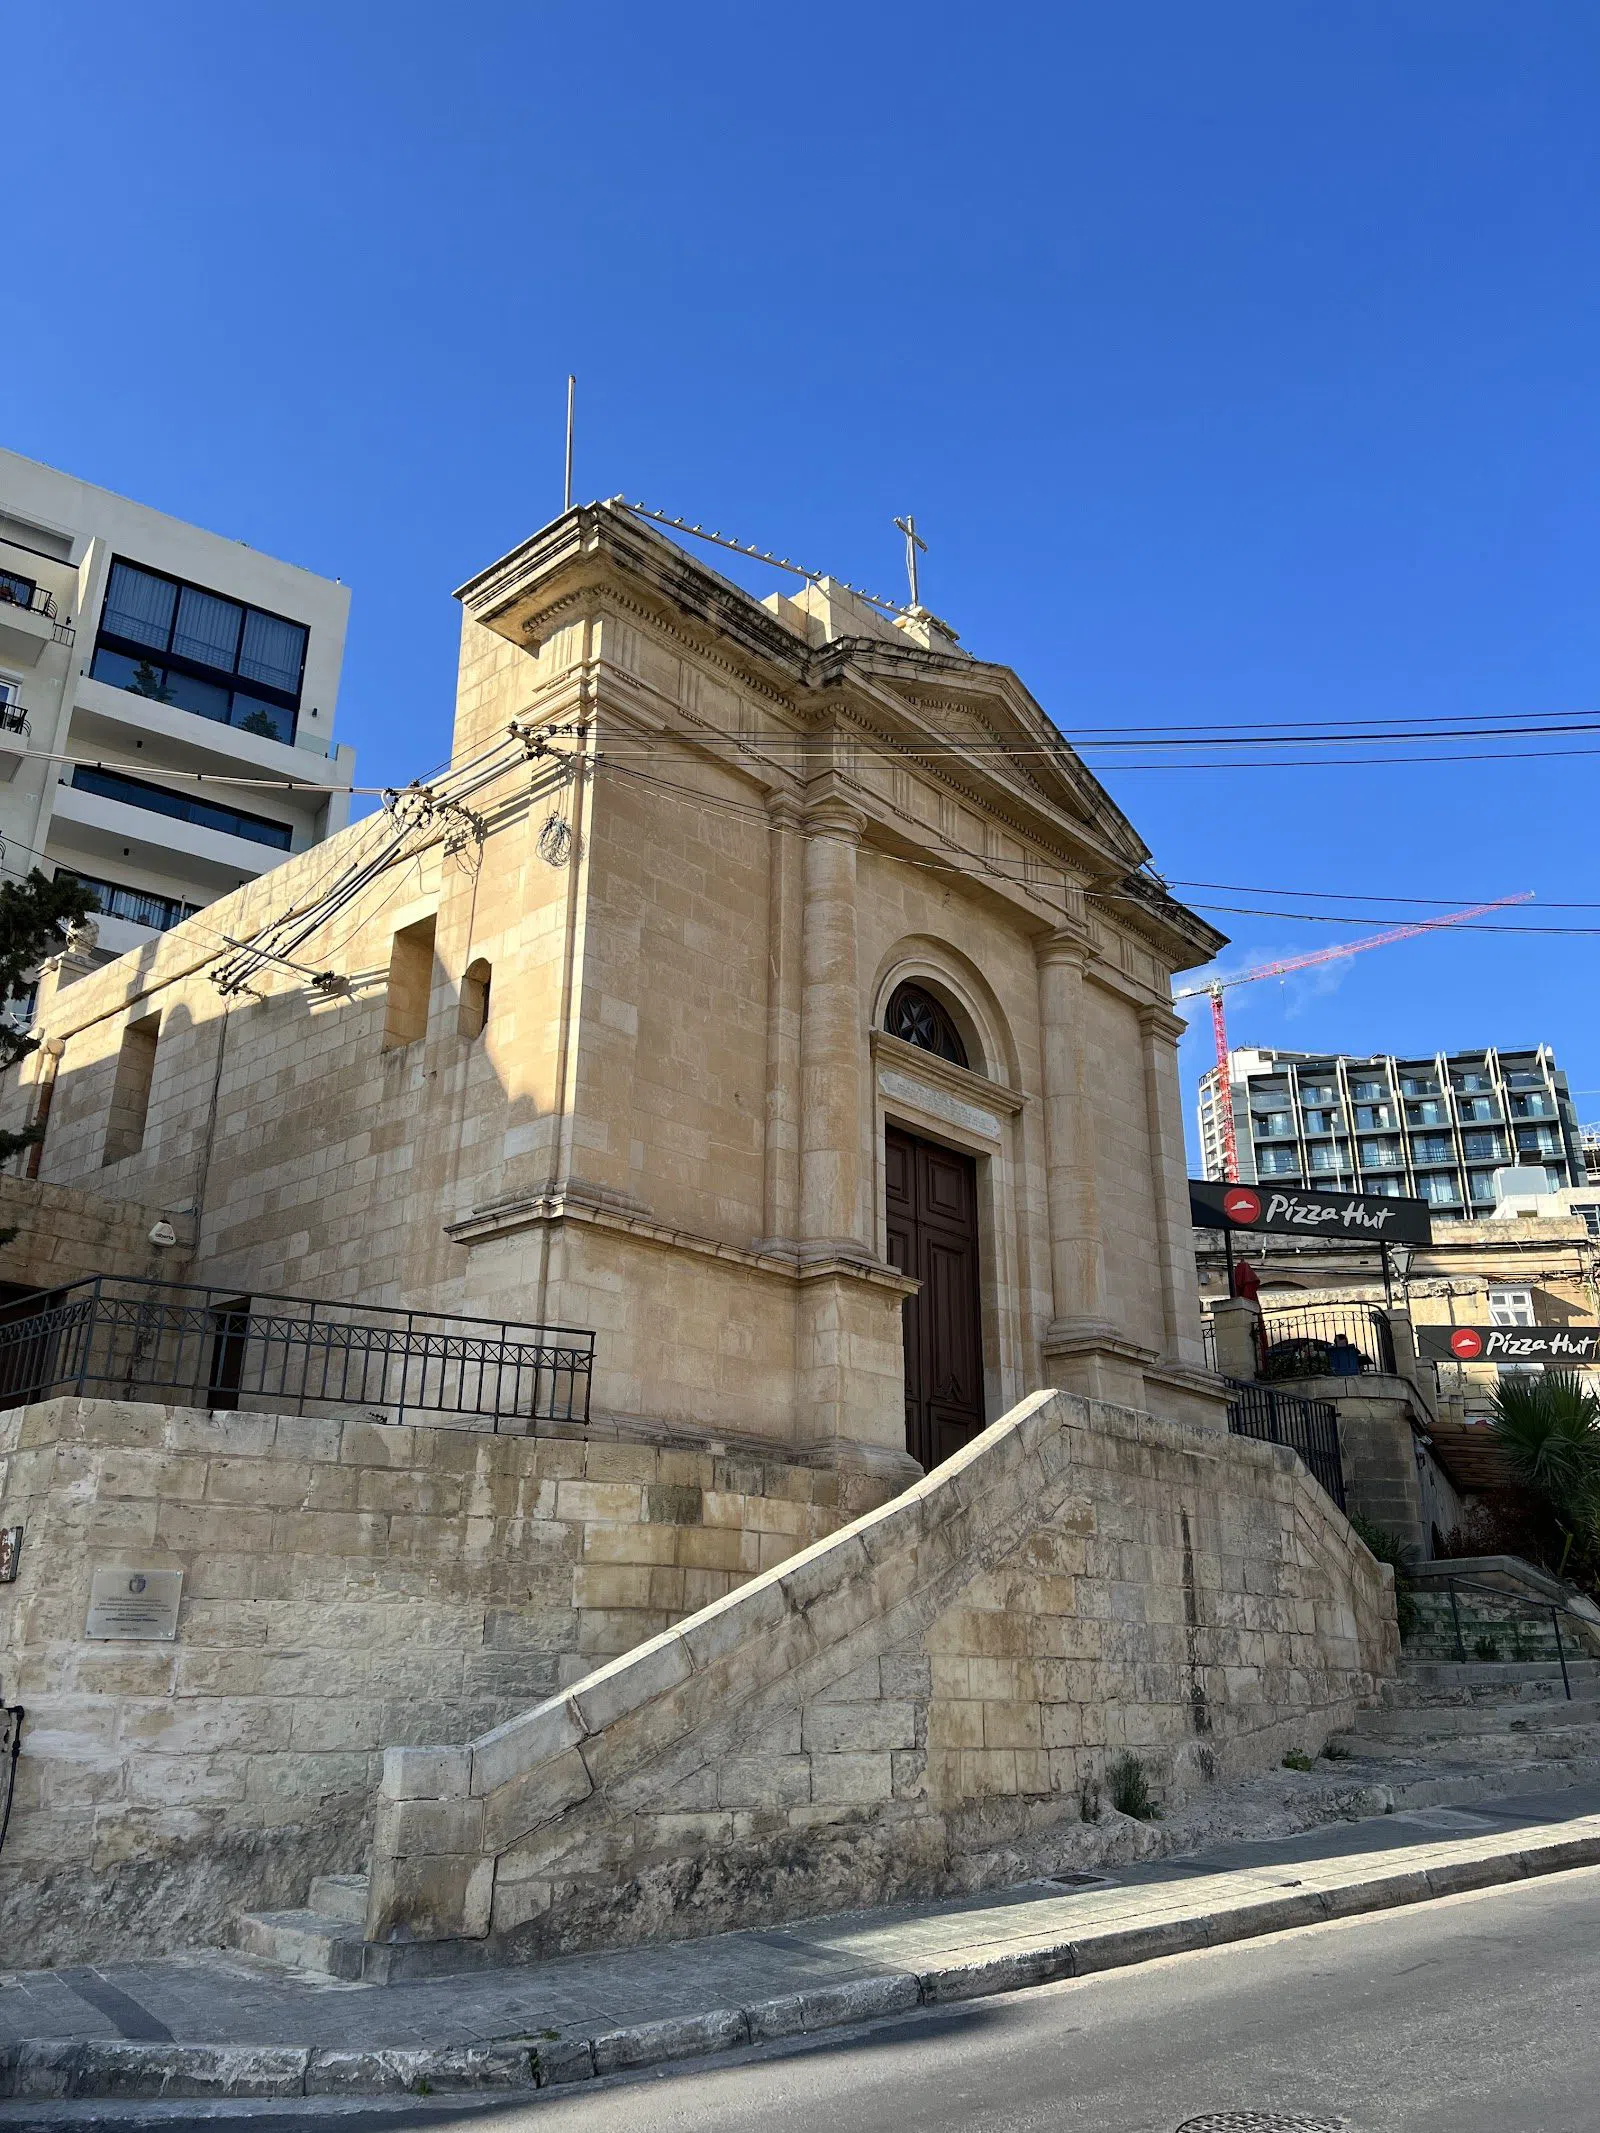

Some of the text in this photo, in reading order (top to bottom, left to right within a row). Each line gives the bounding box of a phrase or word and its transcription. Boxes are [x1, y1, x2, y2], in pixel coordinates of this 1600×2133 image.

[1266, 1194, 1396, 1230] Pizza Hut
[1486, 1332, 1596, 1356] Pizza Hut
